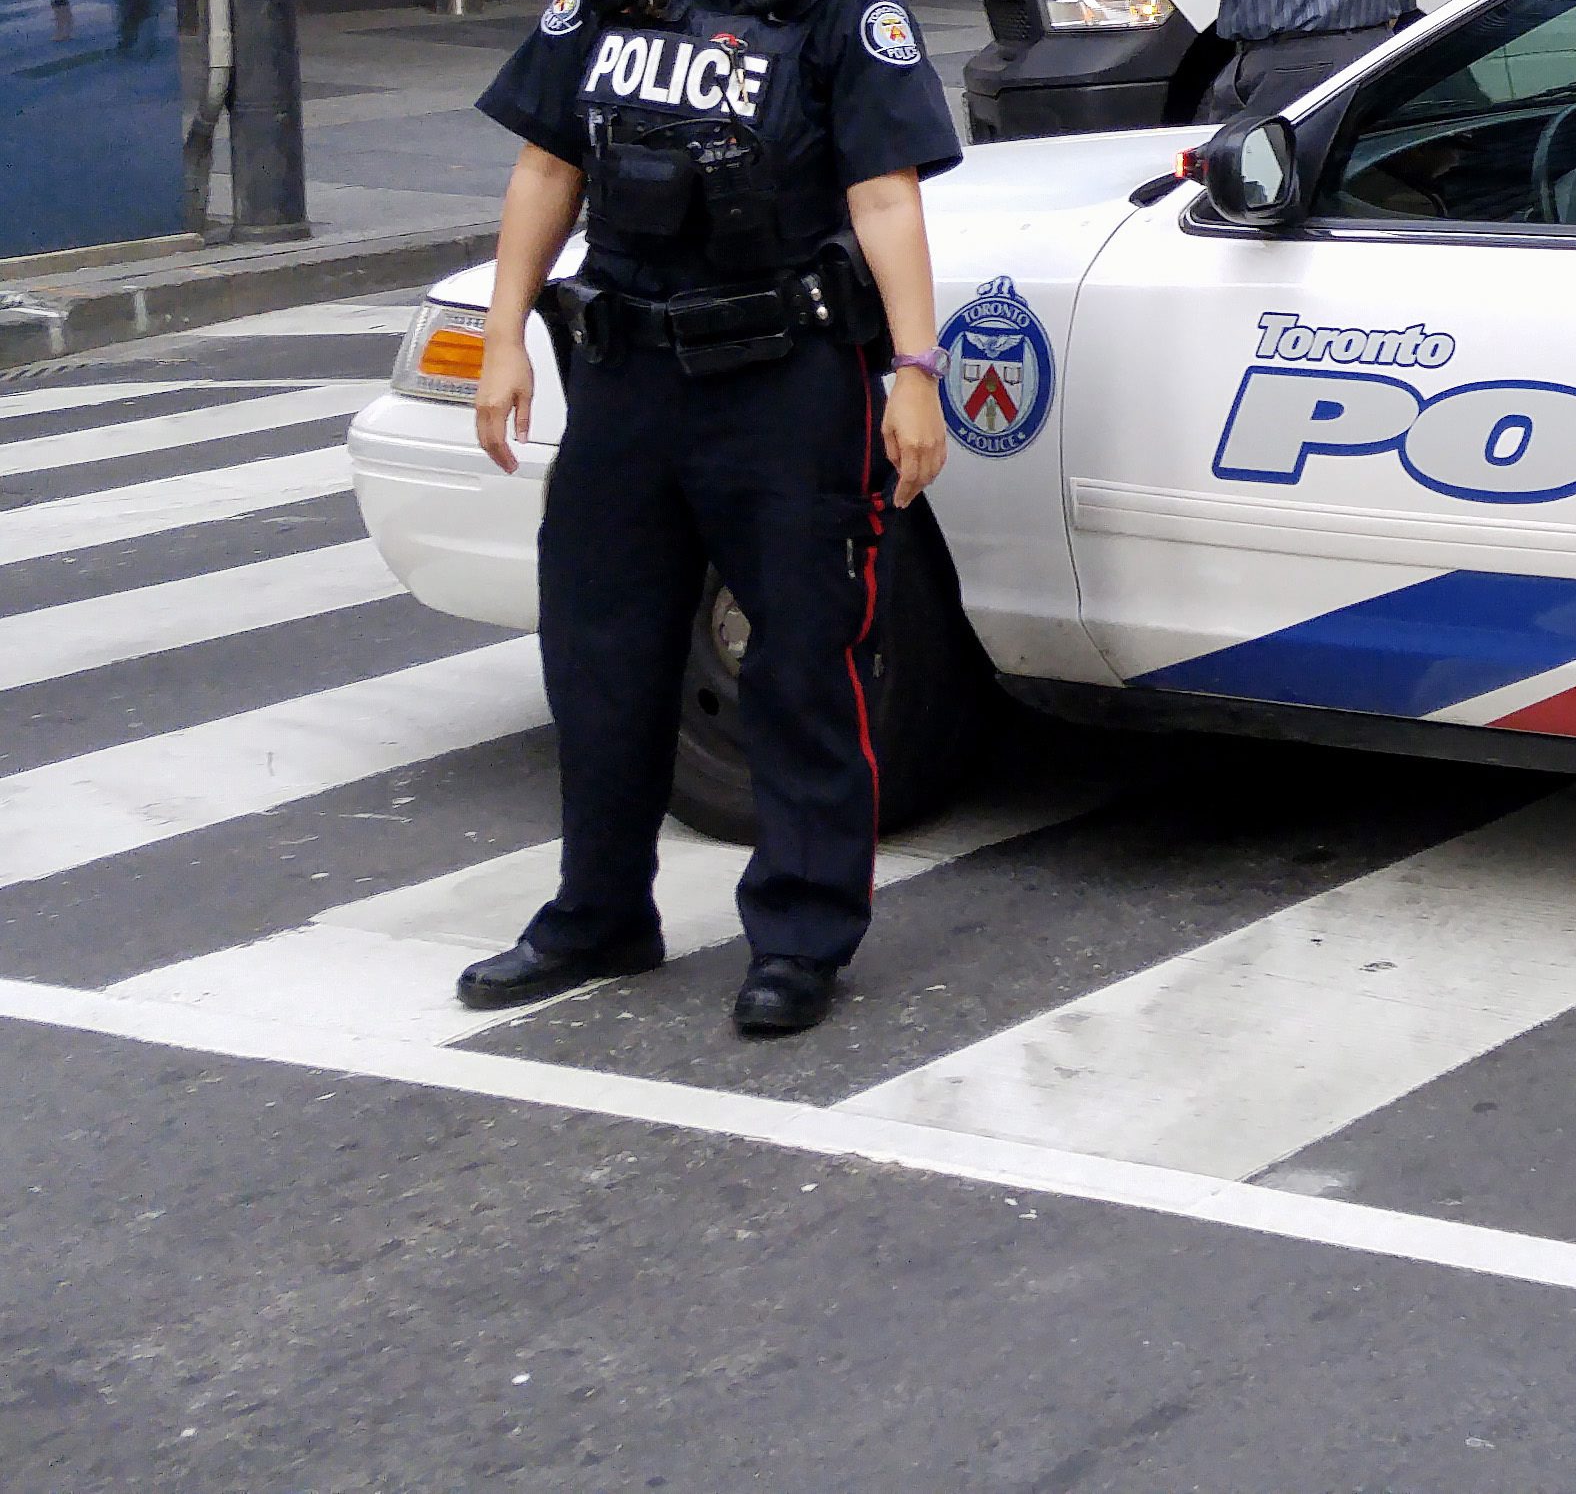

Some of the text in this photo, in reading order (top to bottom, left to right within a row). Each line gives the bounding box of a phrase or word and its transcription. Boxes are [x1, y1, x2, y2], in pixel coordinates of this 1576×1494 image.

[585, 35, 769, 117] POLICE
[962, 303, 1031, 328] TORONTO
[1256, 312, 1456, 369] Toronto
[966, 431, 1018, 452] POLICE
